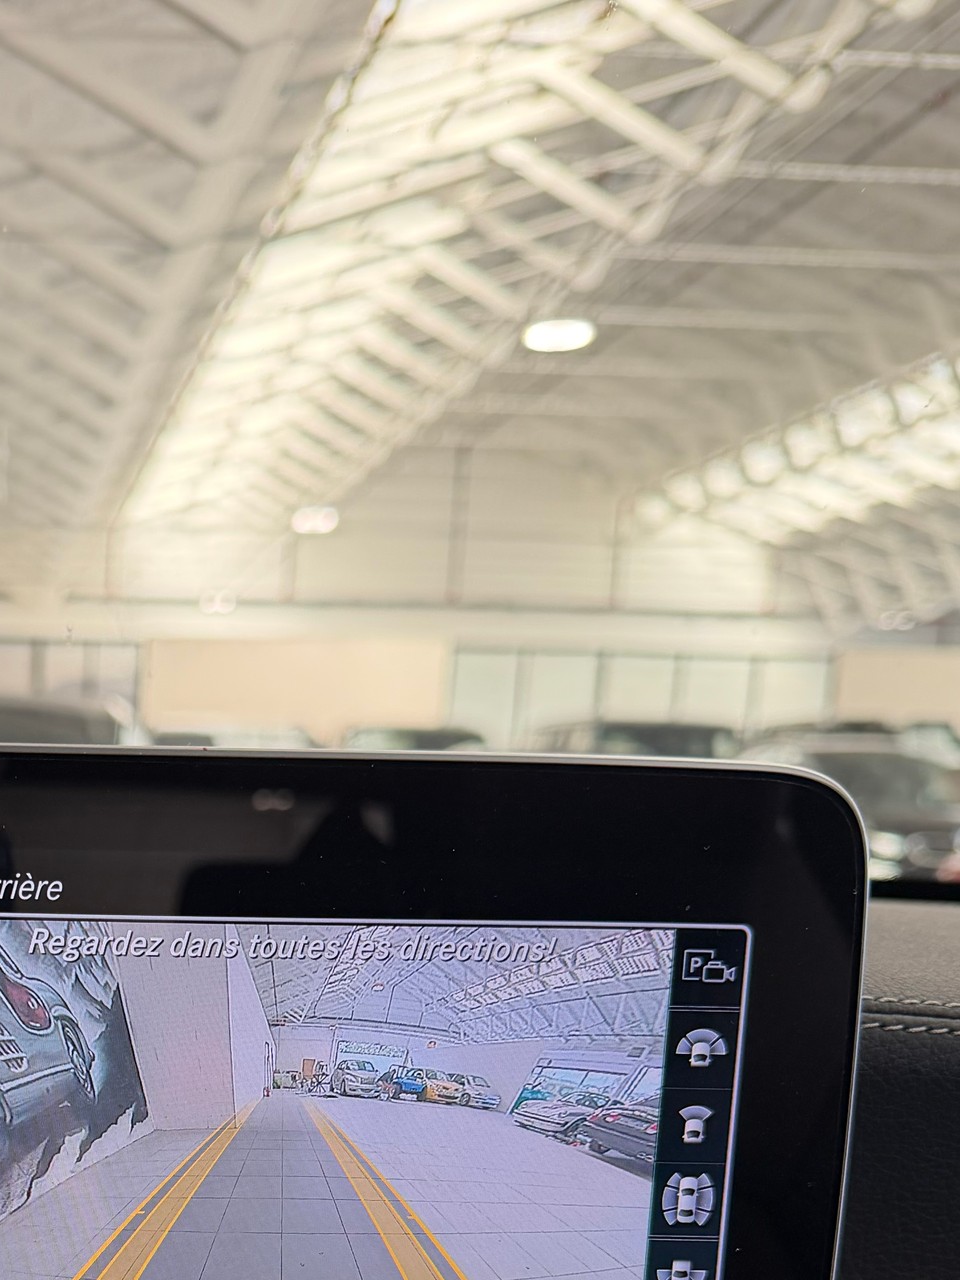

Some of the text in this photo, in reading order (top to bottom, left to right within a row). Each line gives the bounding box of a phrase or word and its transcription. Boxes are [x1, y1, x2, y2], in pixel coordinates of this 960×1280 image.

[28, 927, 558, 963] Regardez dans toutes les directions!
[690, 957, 702, 973] P
